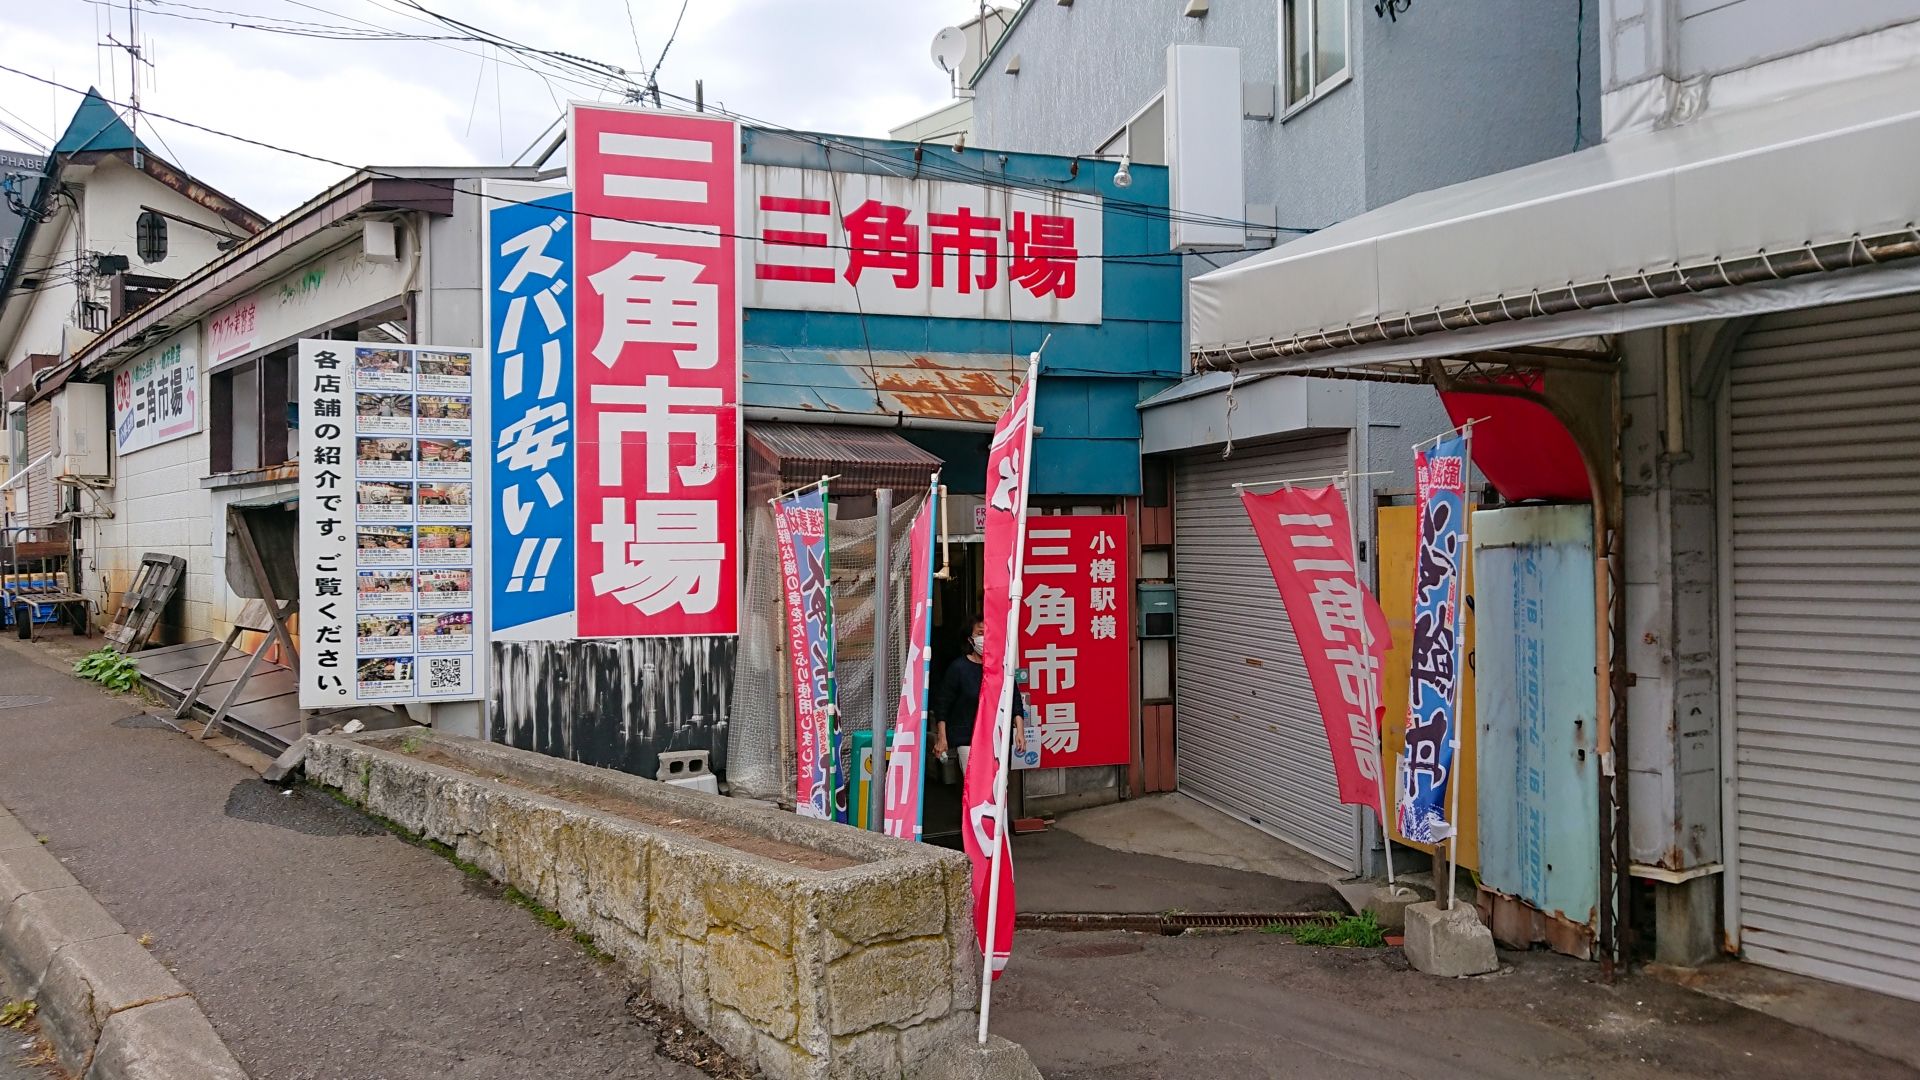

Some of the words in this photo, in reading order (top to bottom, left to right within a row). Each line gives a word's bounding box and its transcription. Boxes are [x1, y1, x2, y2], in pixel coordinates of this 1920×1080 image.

[0, 155, 47, 171] PHABE
[755, 194, 1078, 299] 三角市場
[186, 365, 195, 383] 入口
[212, 302, 256, 347] アルファ美容室
[588, 131, 725, 616] 三角市場
[136, 367, 183, 429] 三角市場
[497, 215, 569, 594] ズバリ安い!!
[1089, 530, 1116, 640] 小樽駅横
[1023, 529, 1080, 755] 三角市場
